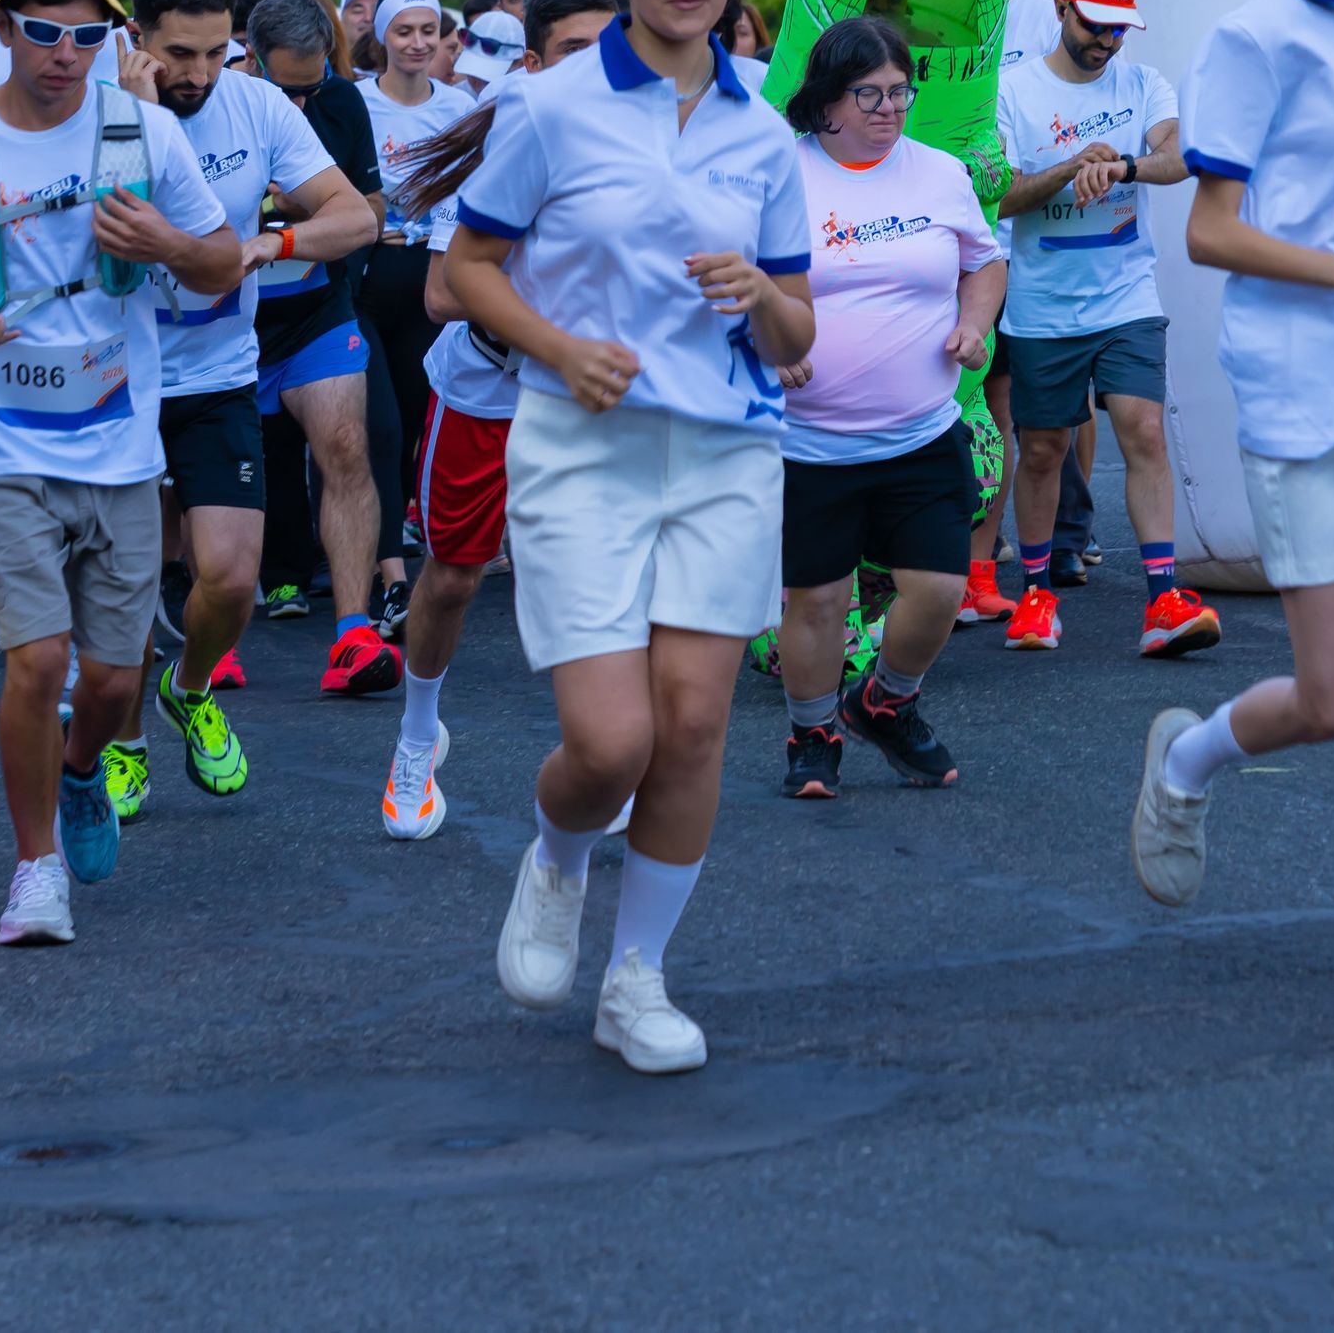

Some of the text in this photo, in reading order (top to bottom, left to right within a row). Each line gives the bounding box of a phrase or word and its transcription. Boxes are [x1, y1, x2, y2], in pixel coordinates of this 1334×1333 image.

[1077, 113, 1104, 133] AGBU
[1079, 110, 1131, 139] Global Run
[219, 153, 244, 171] Run
[32, 175, 73, 202] AGBU
[858, 217, 893, 234] AGBU
[859, 218, 928, 244] Global Run
[0, 361, 65, 388] 1086
